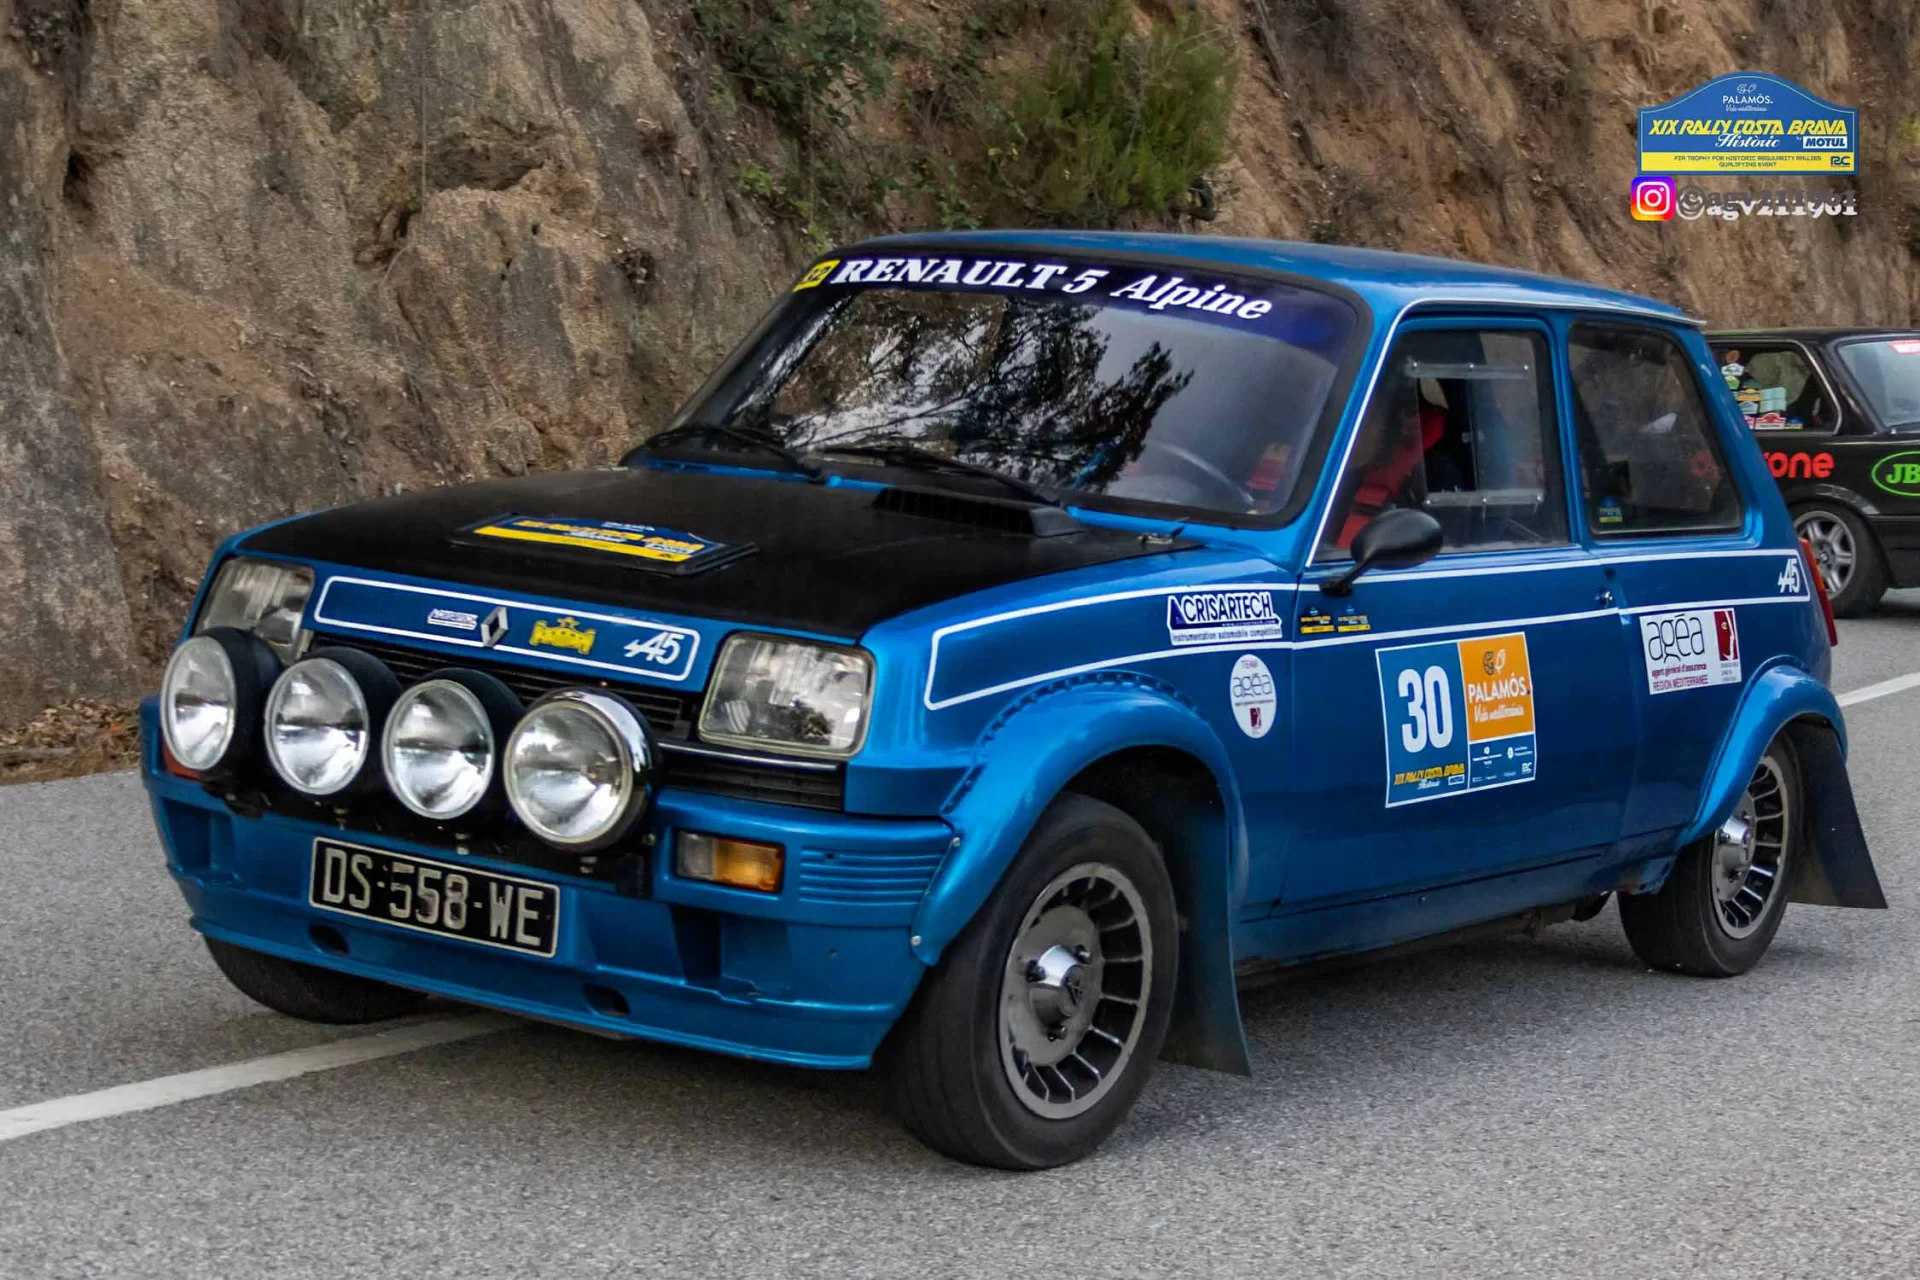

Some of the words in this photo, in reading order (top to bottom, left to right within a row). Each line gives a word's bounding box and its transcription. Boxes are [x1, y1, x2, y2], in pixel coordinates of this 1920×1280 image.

[829, 258, 1064, 291] RENAULT
[1062, 268, 1109, 295] 5
[1110, 273, 1274, 321] Alpine
[1183, 594, 1273, 622] CRISARTECH
[1397, 665, 1454, 753] 30
[1468, 672, 1531, 704] PALAMÓS.
